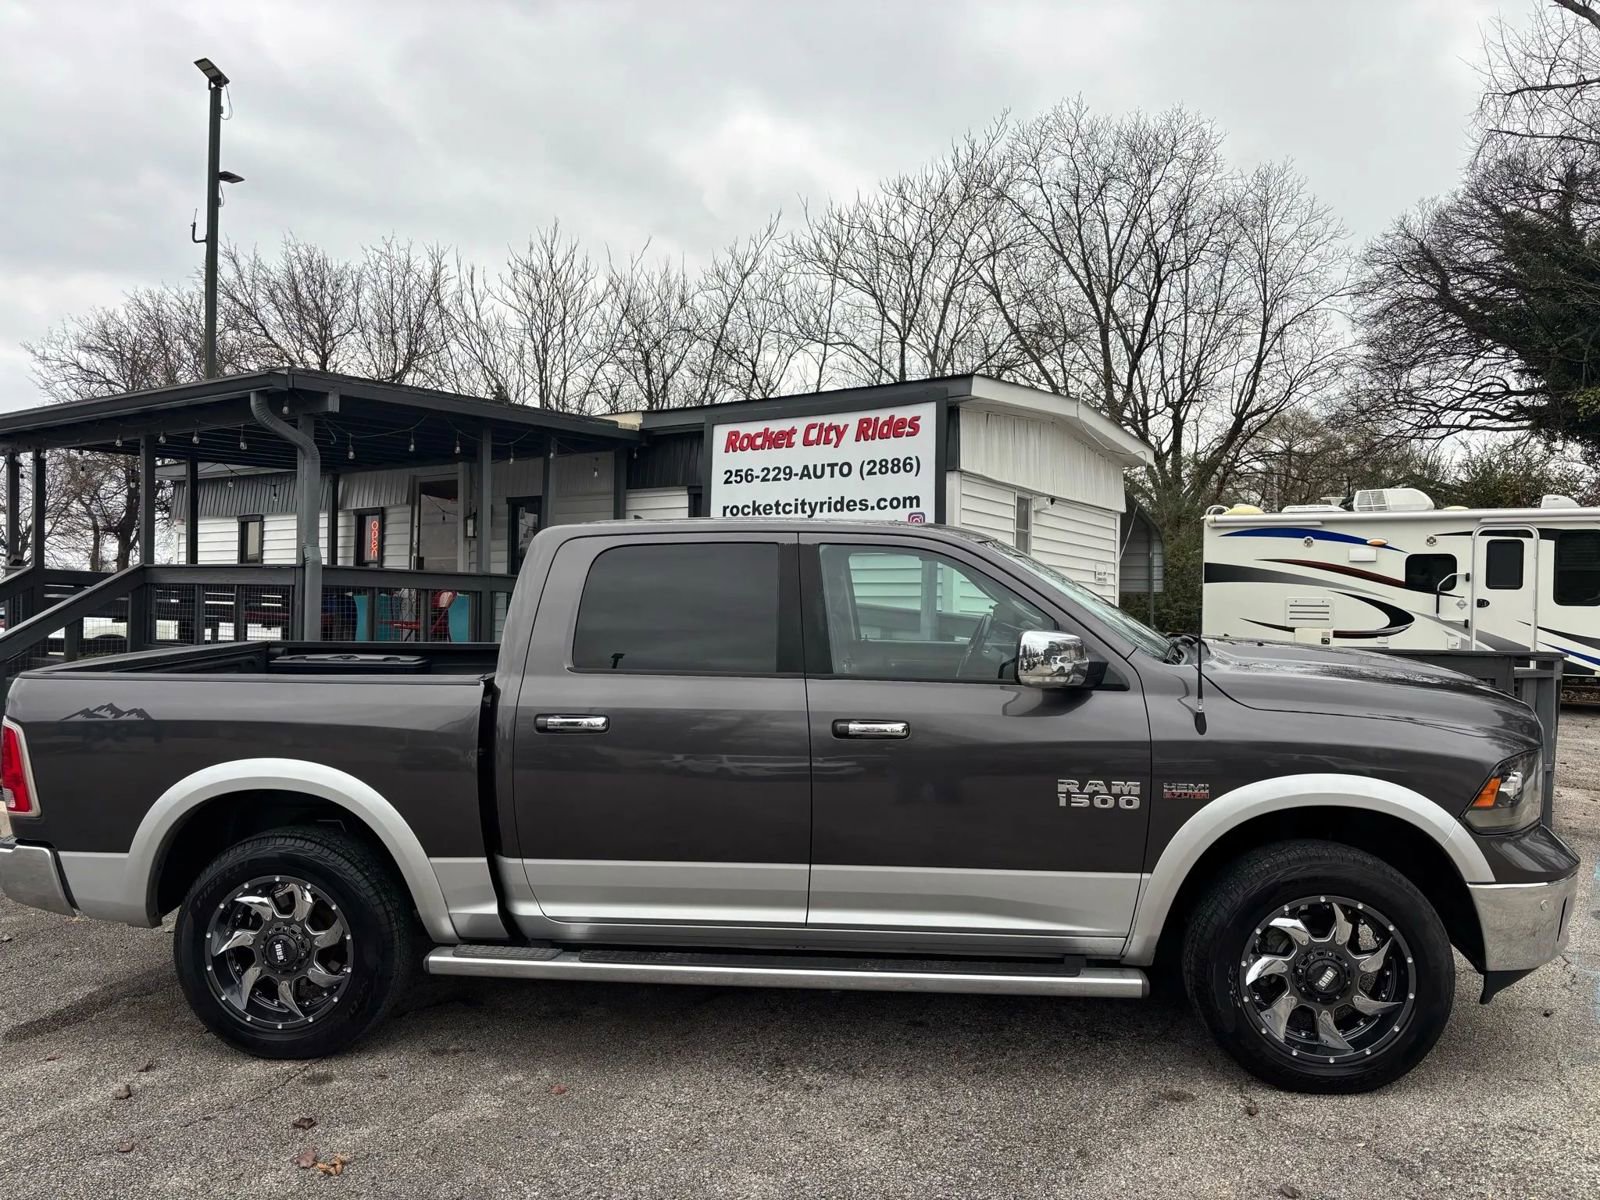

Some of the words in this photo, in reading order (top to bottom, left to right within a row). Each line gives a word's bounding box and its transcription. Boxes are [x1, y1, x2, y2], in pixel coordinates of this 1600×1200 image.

[724, 425, 797, 453] Rocket
[802, 422, 849, 448] City
[855, 415, 921, 443] Rides
[723, 461, 852, 485] 256-229-AUTO
[859, 455, 921, 481] (2886)
[722, 494, 921, 518] rocketcityrides.com
[1057, 779, 1140, 795] RAM
[1163, 782, 1209, 793] HEMI
[1057, 793, 1140, 810] 1500
[1318, 970, 1334, 987] GRID
